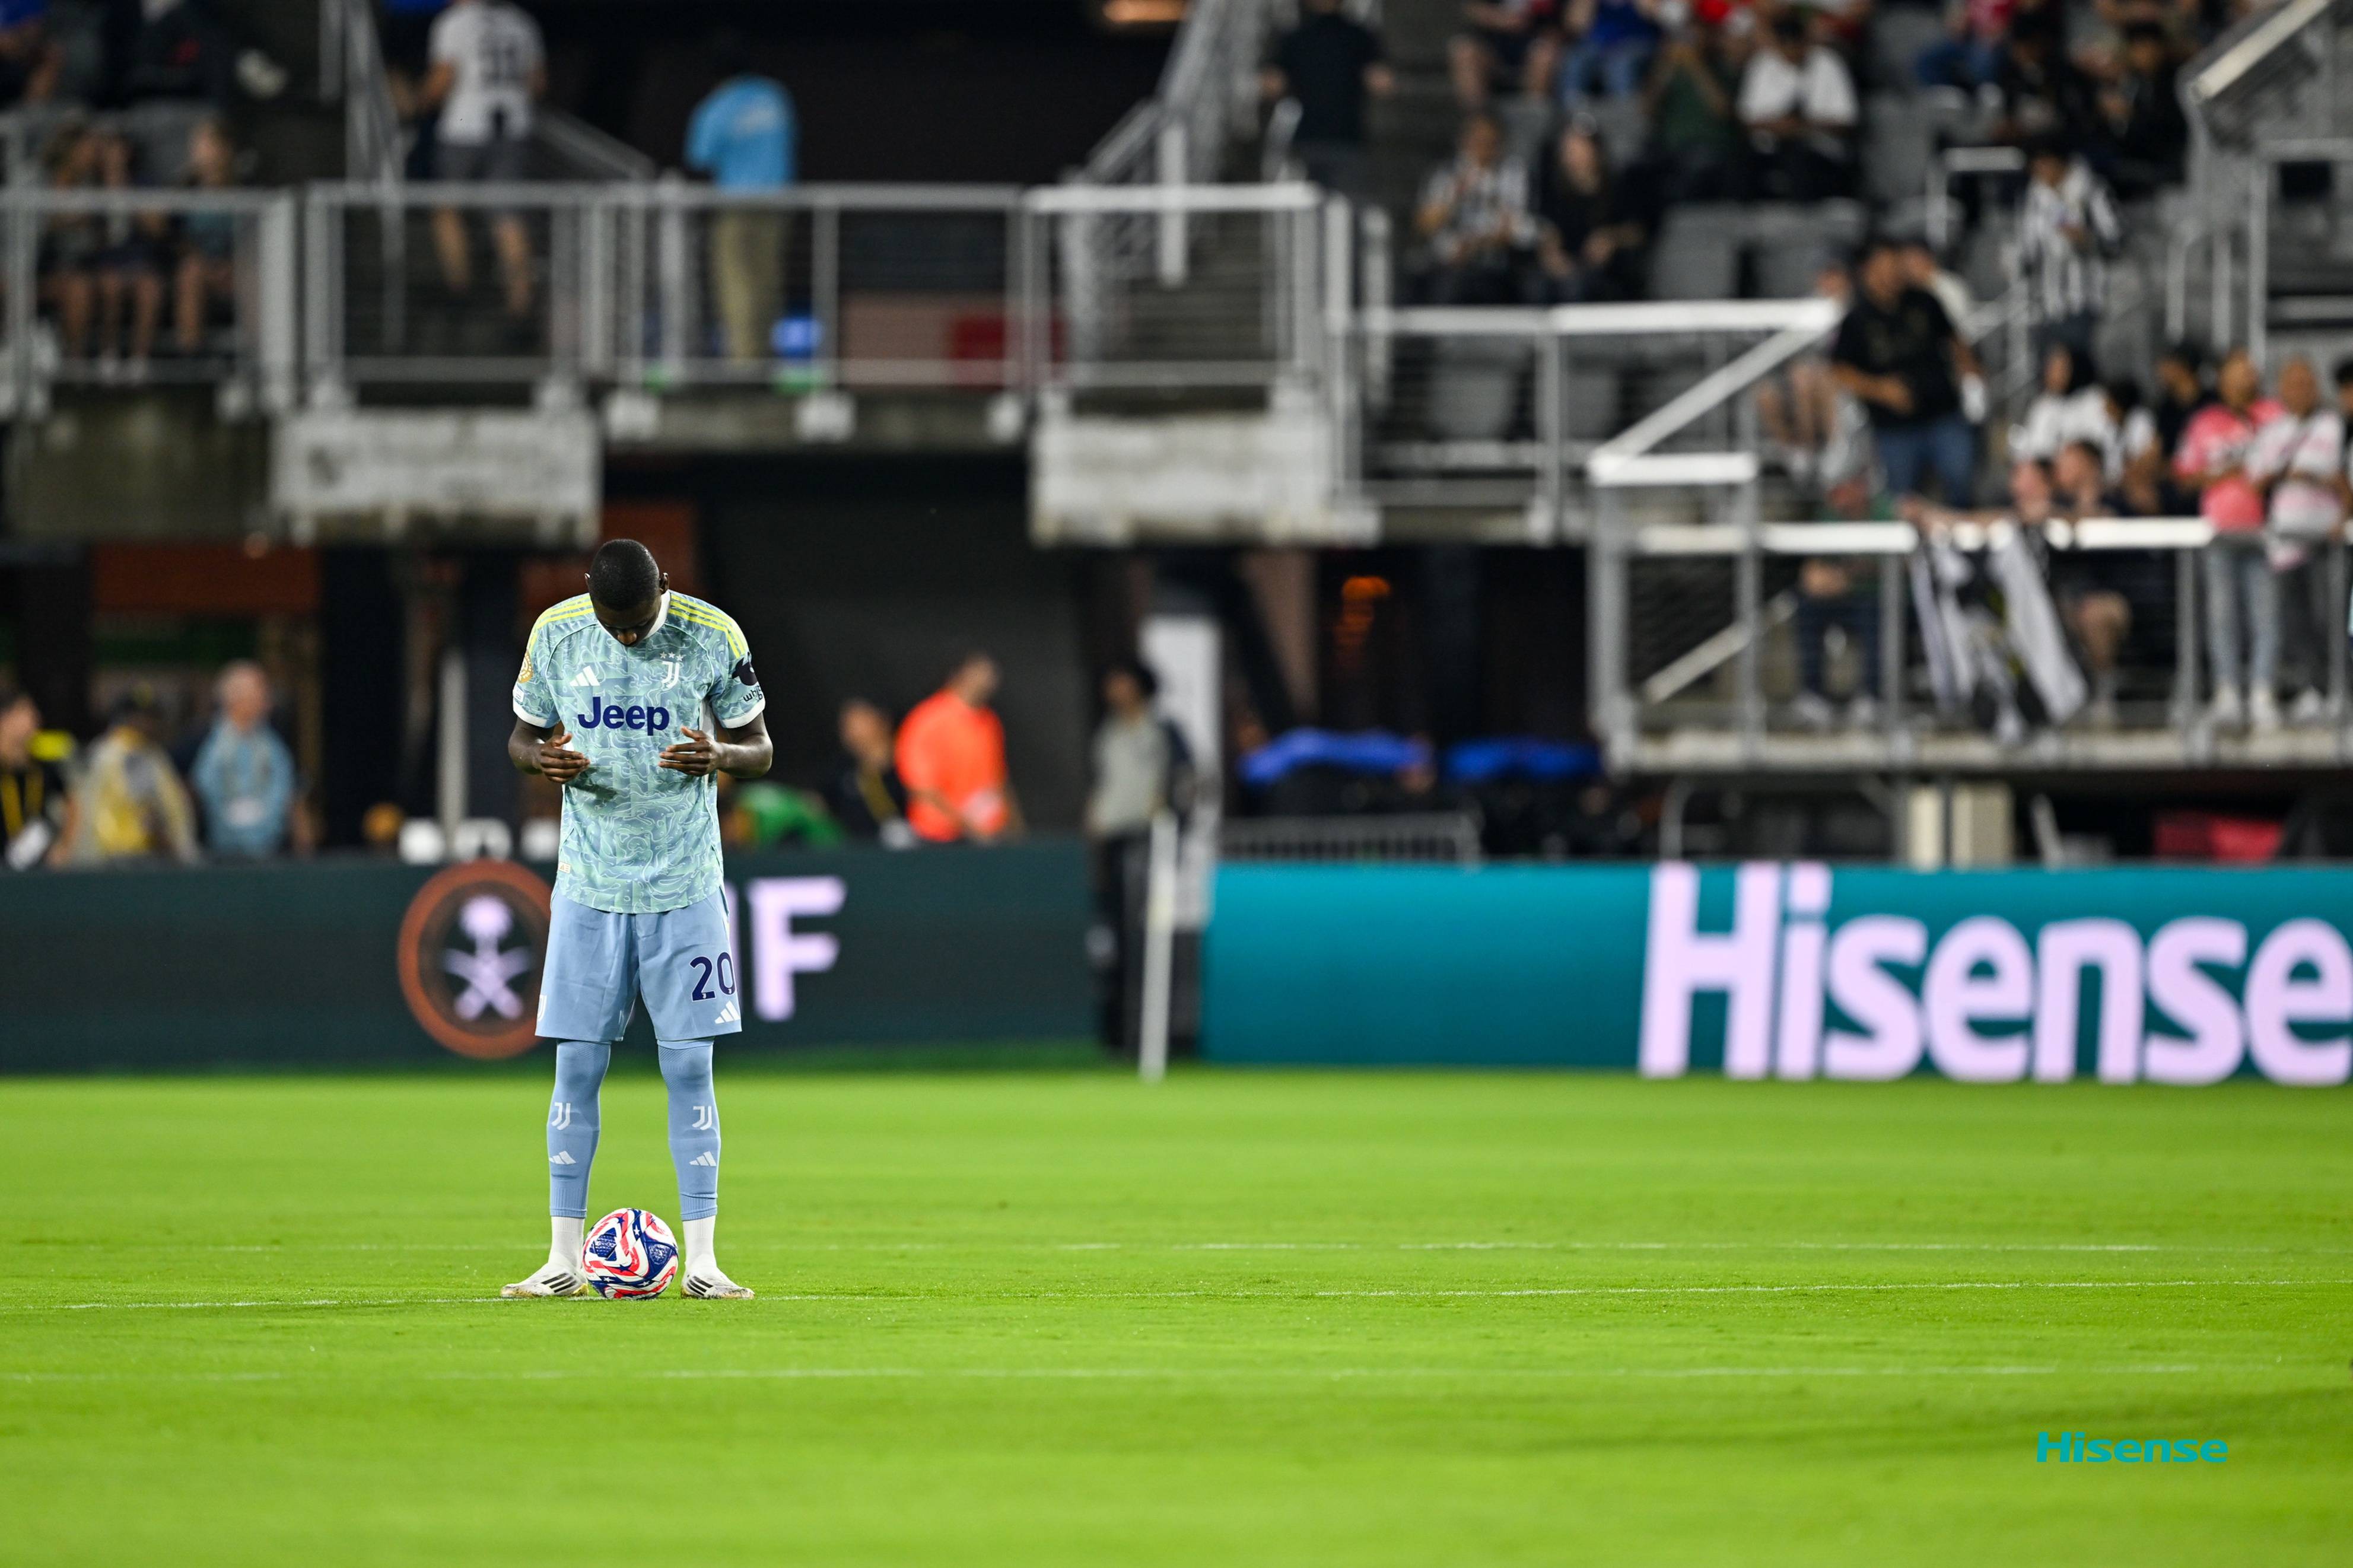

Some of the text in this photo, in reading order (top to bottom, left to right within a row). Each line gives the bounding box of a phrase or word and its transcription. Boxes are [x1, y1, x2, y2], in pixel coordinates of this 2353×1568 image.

[577, 696, 670, 736] Jeep
[689, 952, 736, 1001] 20
[1637, 861, 2353, 1087] Hisense
